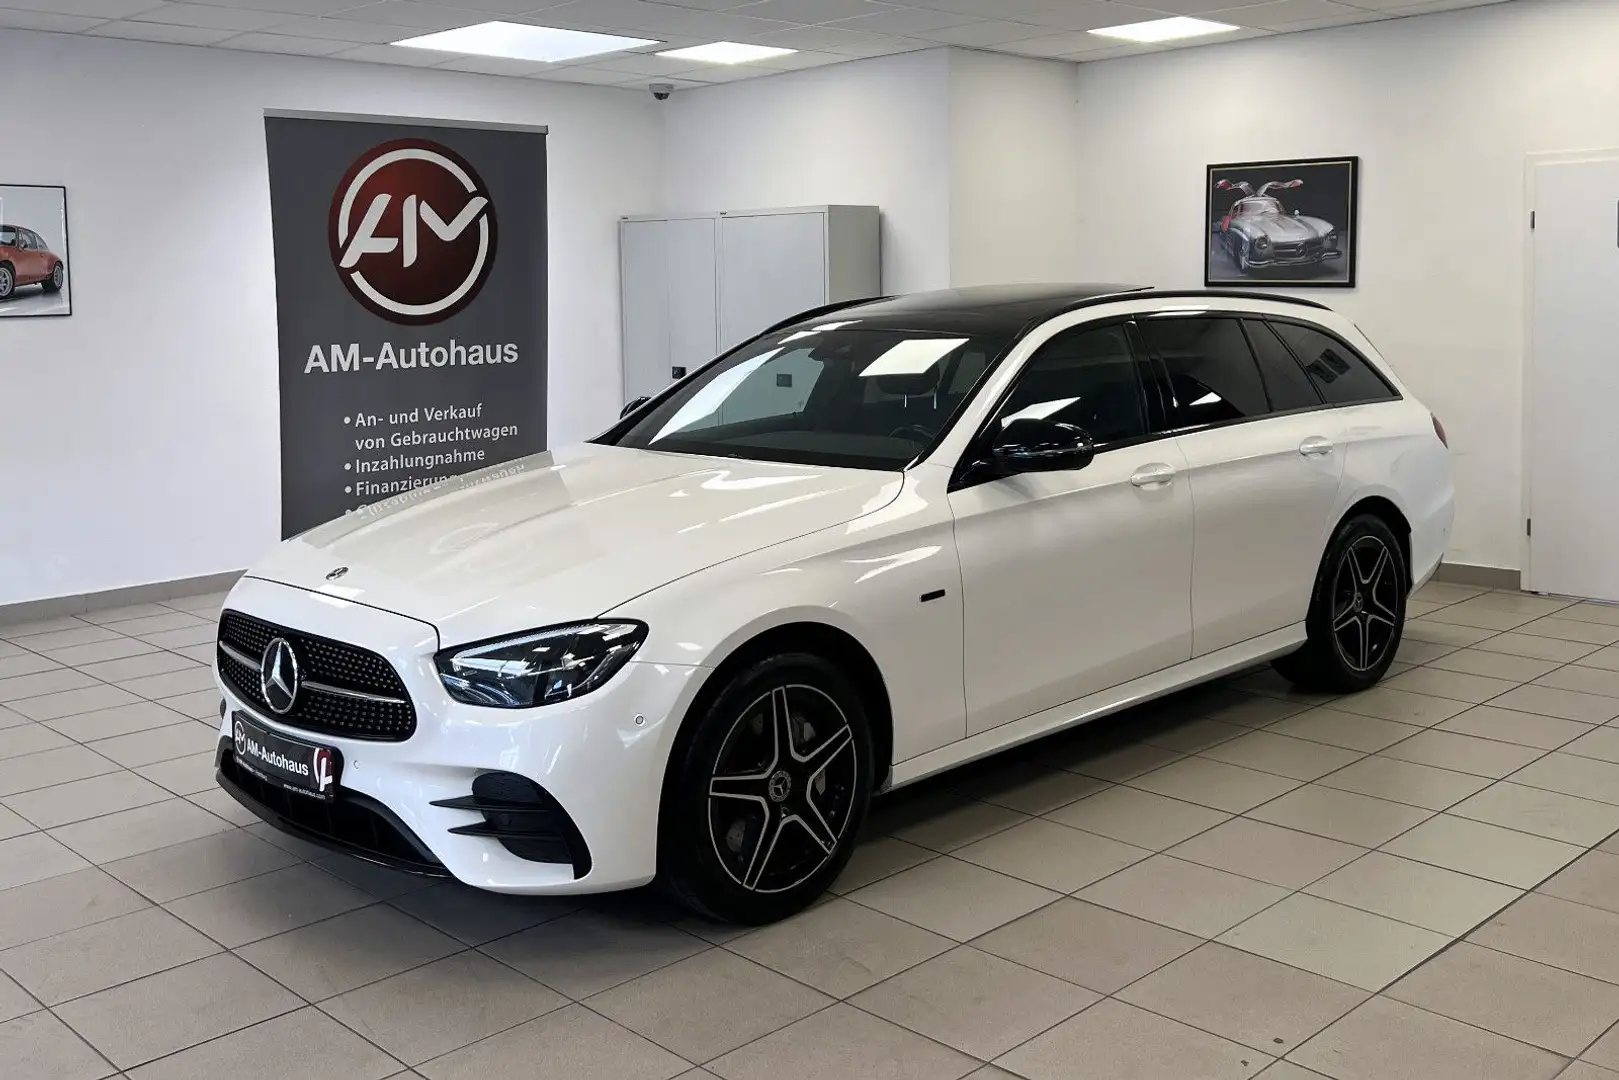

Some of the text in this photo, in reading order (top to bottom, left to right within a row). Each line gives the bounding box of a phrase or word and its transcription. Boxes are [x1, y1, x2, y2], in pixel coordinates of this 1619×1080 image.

[304, 340, 519, 373] AM-Autohaus
[354, 403, 483, 427] An- und Verkauf
[354, 424, 518, 450] von Gebrauchtwagen
[356, 449, 485, 473] Inzahlungnahme
[247, 738, 308, 776] AM-Autohaus
